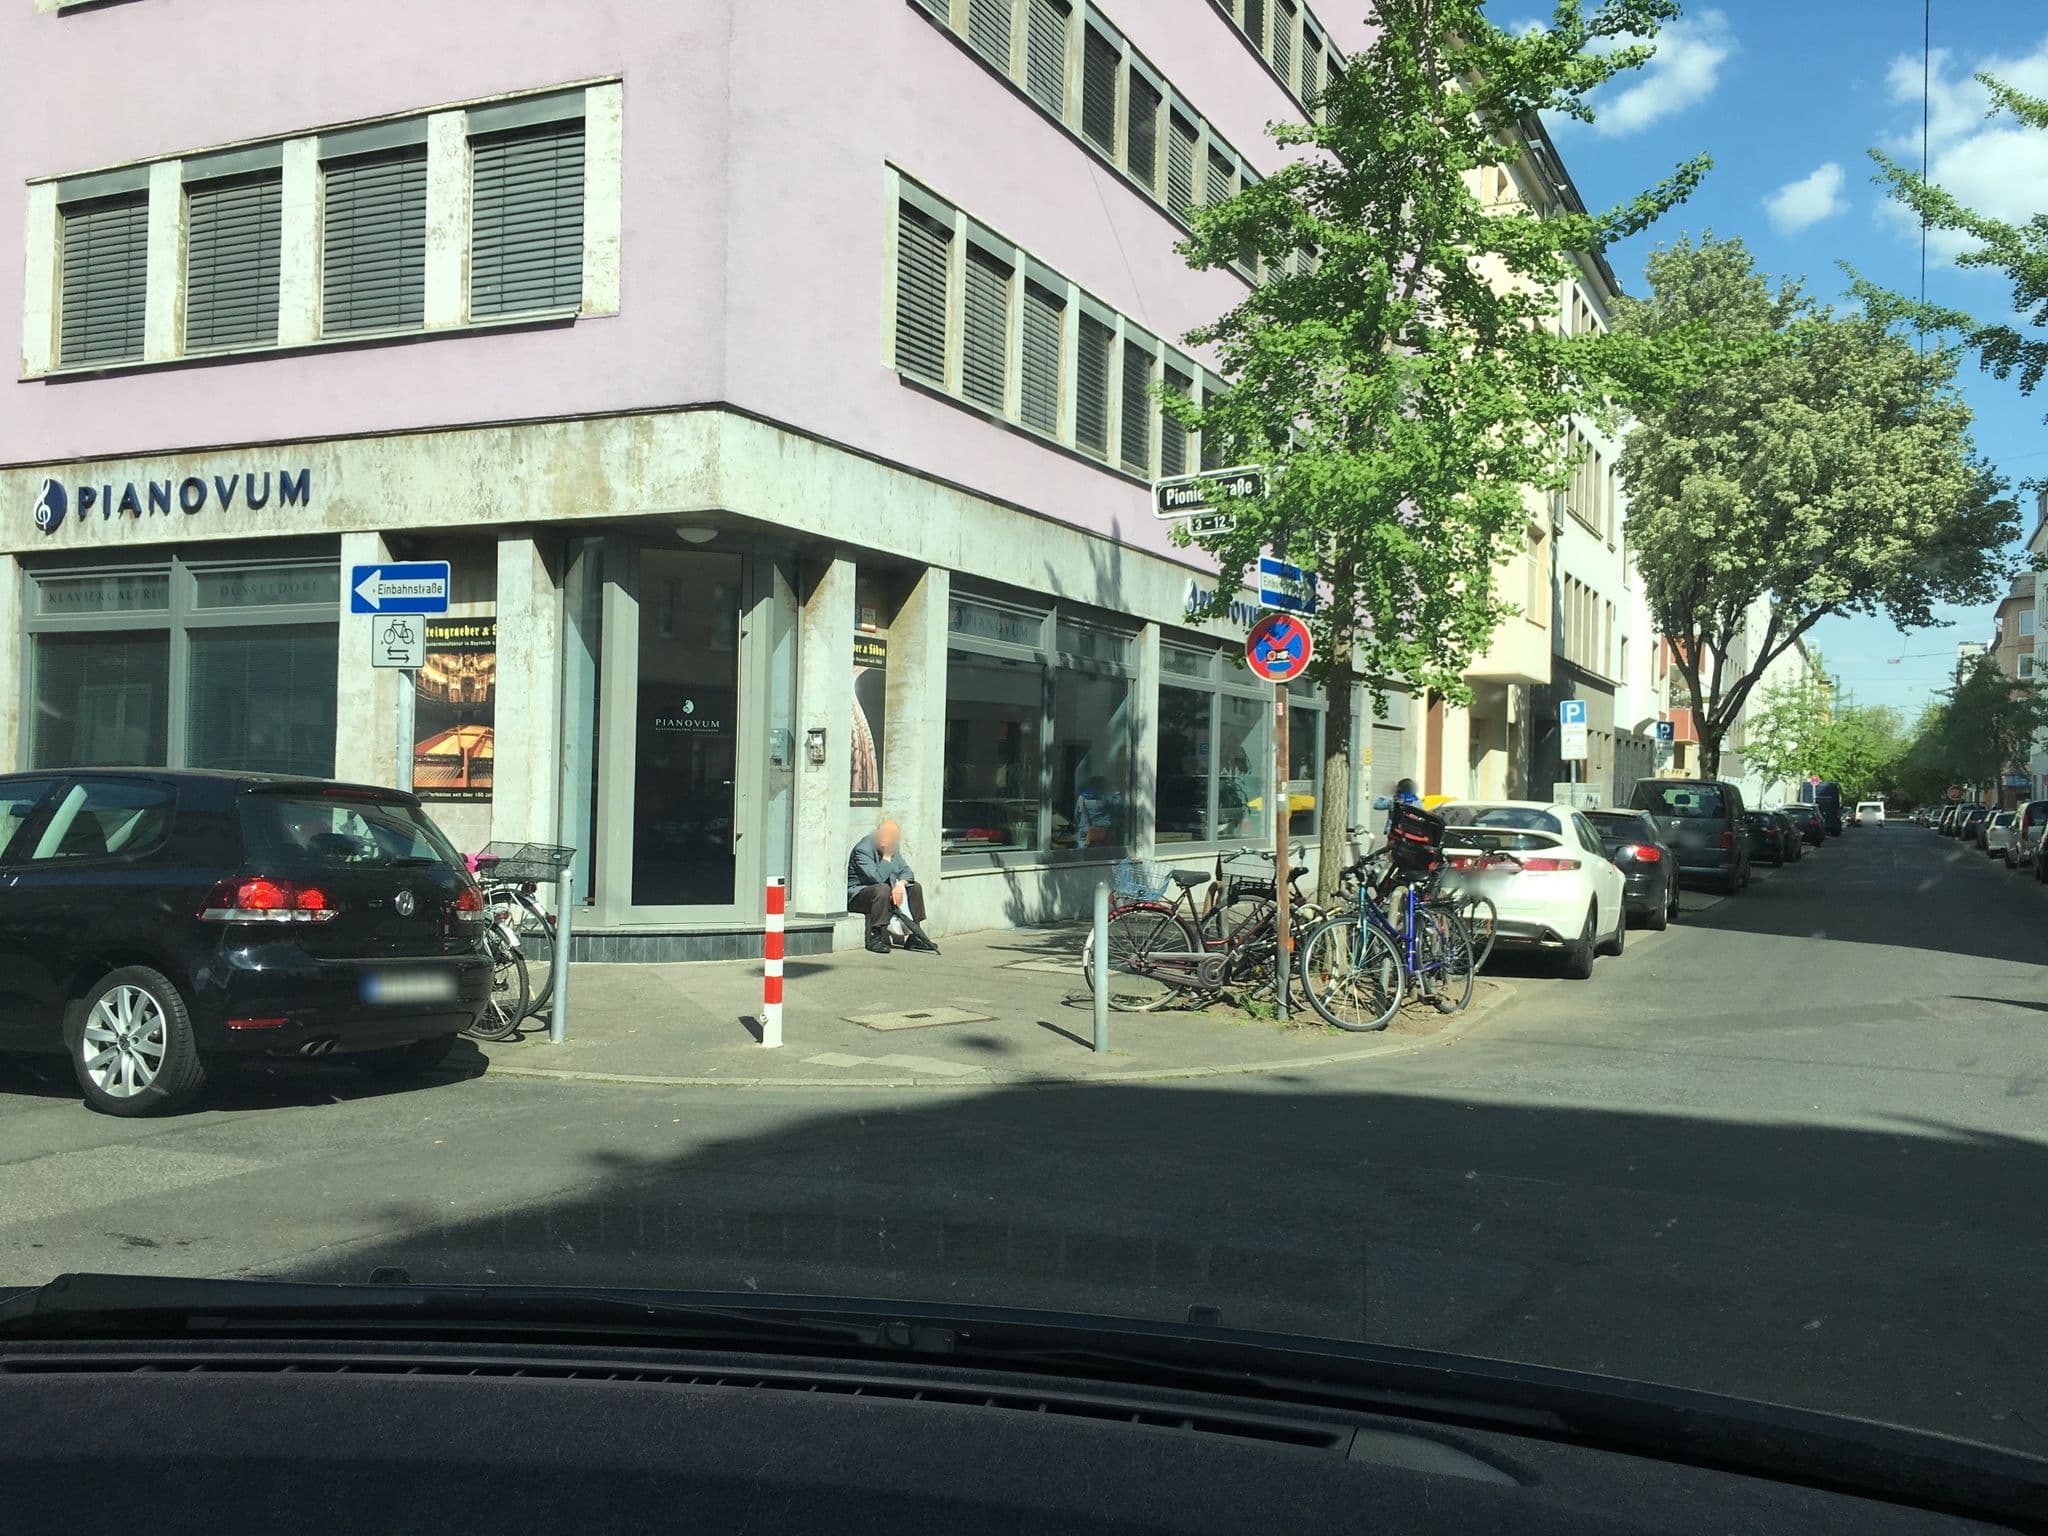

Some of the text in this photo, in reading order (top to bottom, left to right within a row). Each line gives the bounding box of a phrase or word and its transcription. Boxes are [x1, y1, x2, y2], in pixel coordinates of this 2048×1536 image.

[78, 468, 311, 523] PIANOVUM
[1166, 478, 1253, 506] Pionieaße
[1194, 519, 1202, 531] 3
[1214, 515, 1226, 529] 12
[377, 583, 443, 595] Einbahnstraße
[426, 624, 480, 640] teingraeber
[1566, 703, 1580, 723] P
[655, 718, 720, 728] PIANOVUM
